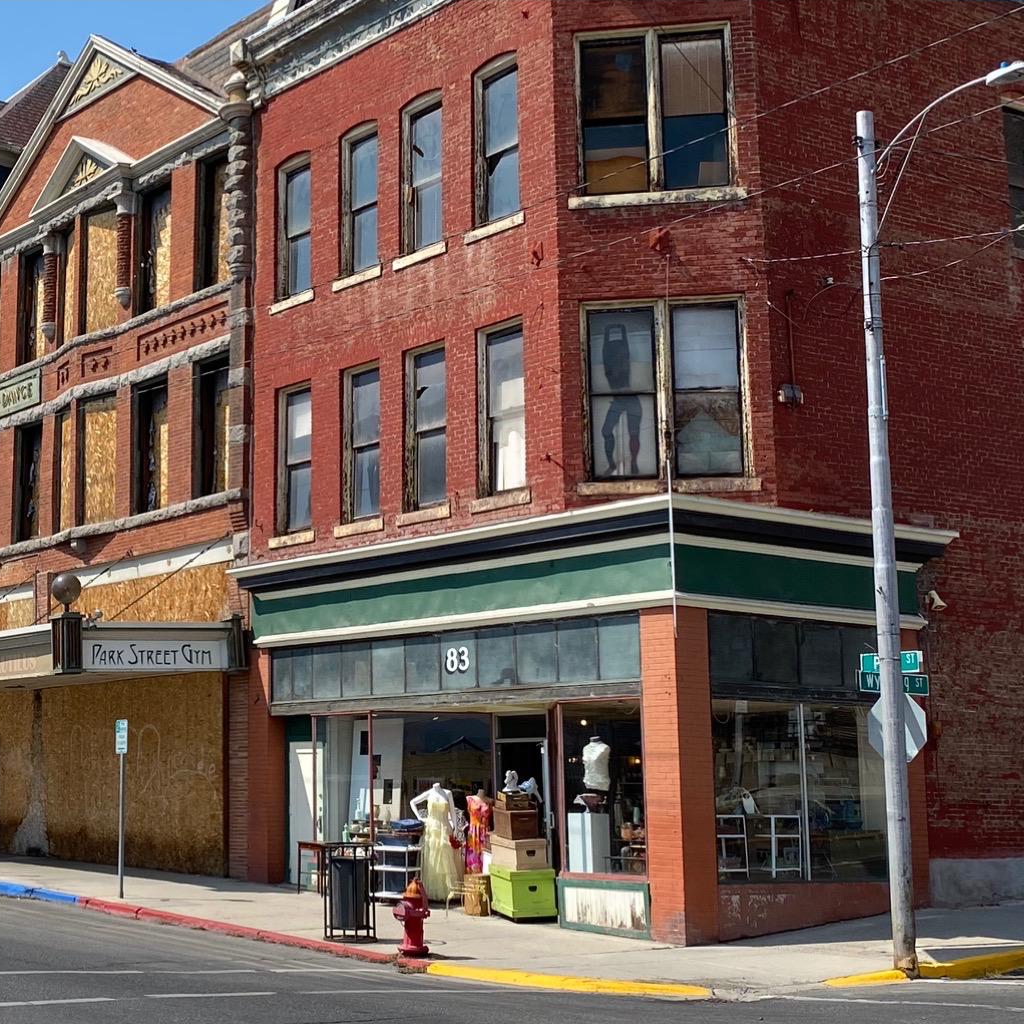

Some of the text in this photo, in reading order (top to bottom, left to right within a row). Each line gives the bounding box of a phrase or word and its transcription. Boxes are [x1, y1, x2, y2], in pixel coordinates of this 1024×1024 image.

[92, 644, 212, 665] PARK STREET GYM
[446, 646, 470, 673] 83
[905, 653, 915, 664] ST
[915, 677, 923, 688] ST
